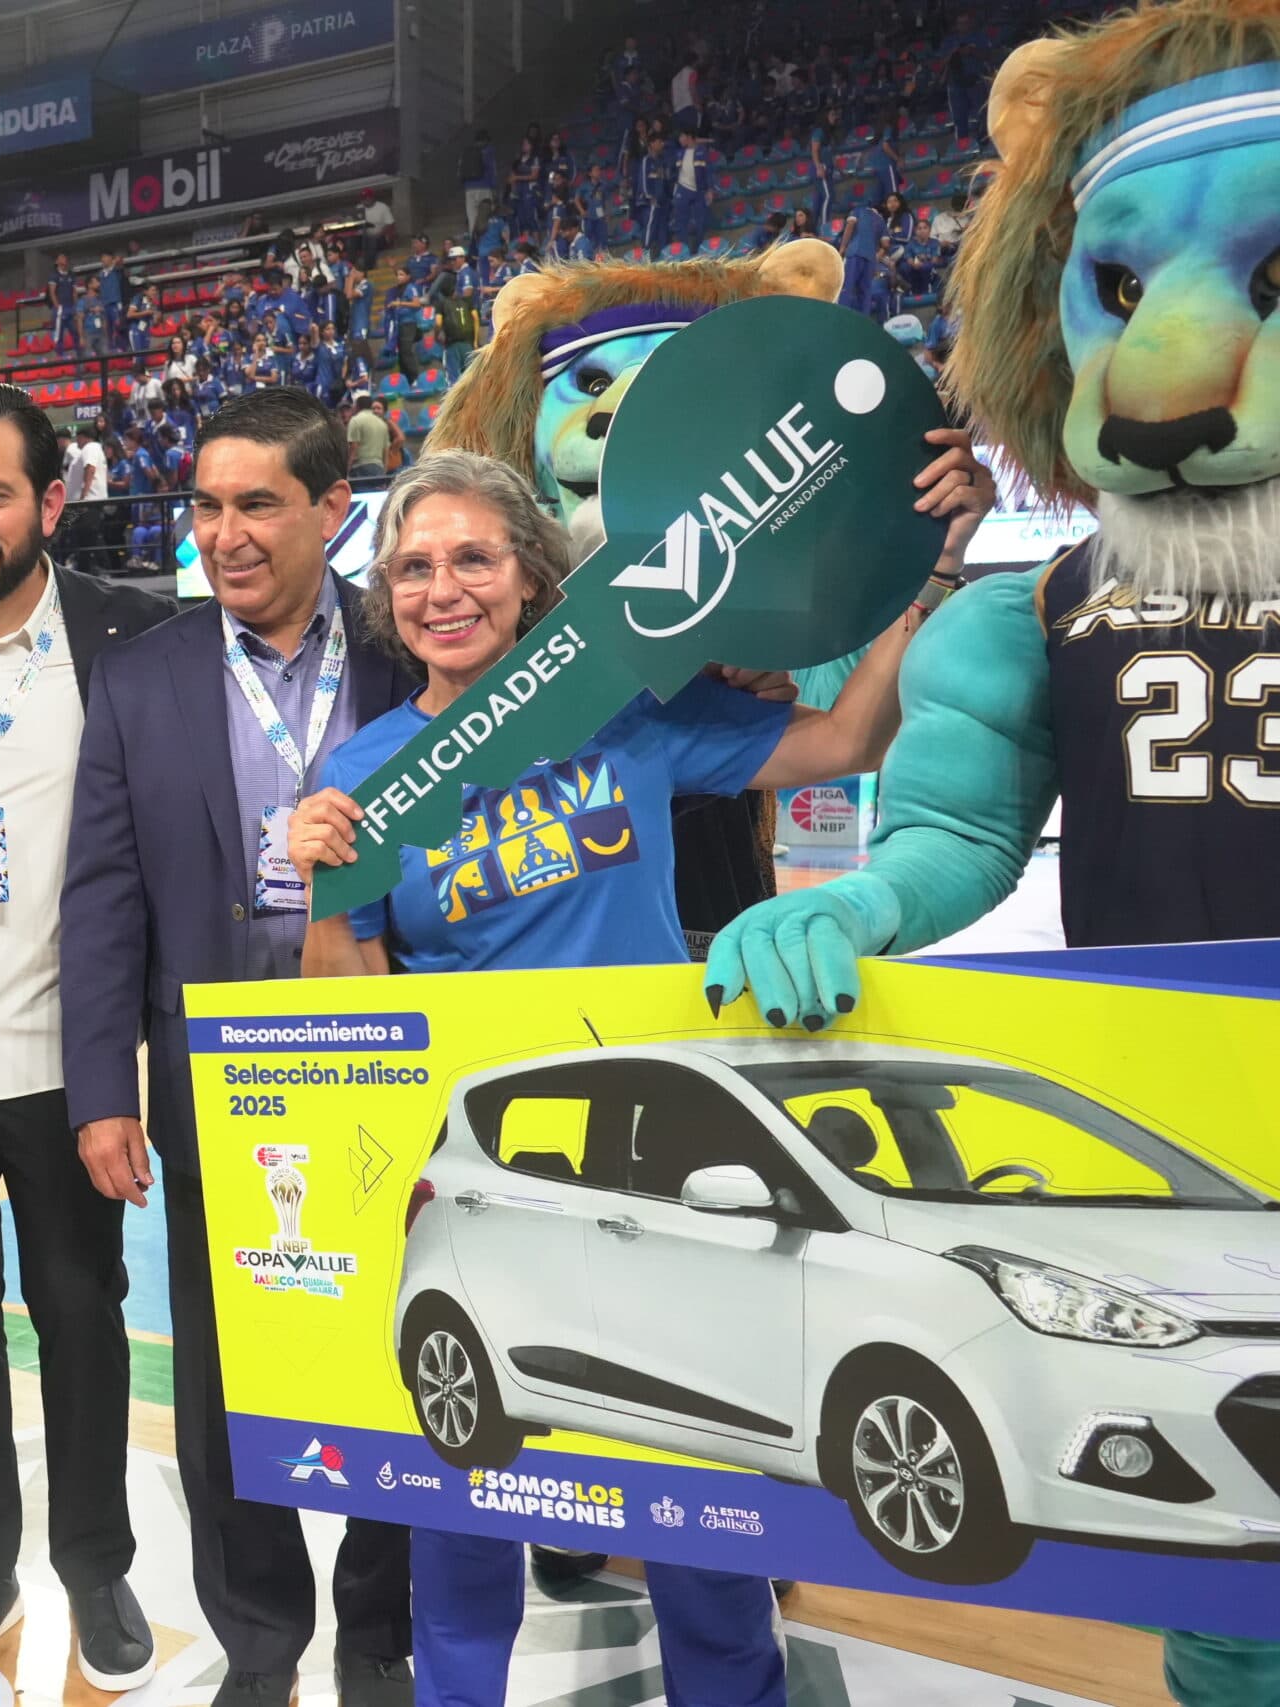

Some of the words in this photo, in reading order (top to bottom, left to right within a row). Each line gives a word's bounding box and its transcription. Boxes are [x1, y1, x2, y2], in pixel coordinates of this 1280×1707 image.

[195, 35, 253, 62] PLAZA
[290, 10, 356, 40] PATRIA
[89, 149, 221, 222] Mobil
[608, 401, 835, 604] VALUE
[770, 455, 849, 535] ARRENDADORA
[361, 624, 587, 845] ¡FELICIDADES!
[812, 788, 845, 800] LIGA
[812, 821, 846, 833] LNBP
[220, 1021, 388, 1044] Reconocimiento
[390, 1025, 404, 1041] a
[224, 1061, 339, 1085] Selección
[343, 1060, 429, 1085] Jalisco
[229, 1095, 287, 1116] 2025
[276, 1240, 308, 1253] LNBP
[254, 1274, 296, 1287] JALISCO
[402, 1473, 442, 1490] CODE
[703, 1504, 719, 1516] AL
[720, 1506, 760, 1521] ESTILO
[470, 1488, 626, 1529] CAMPEONES
